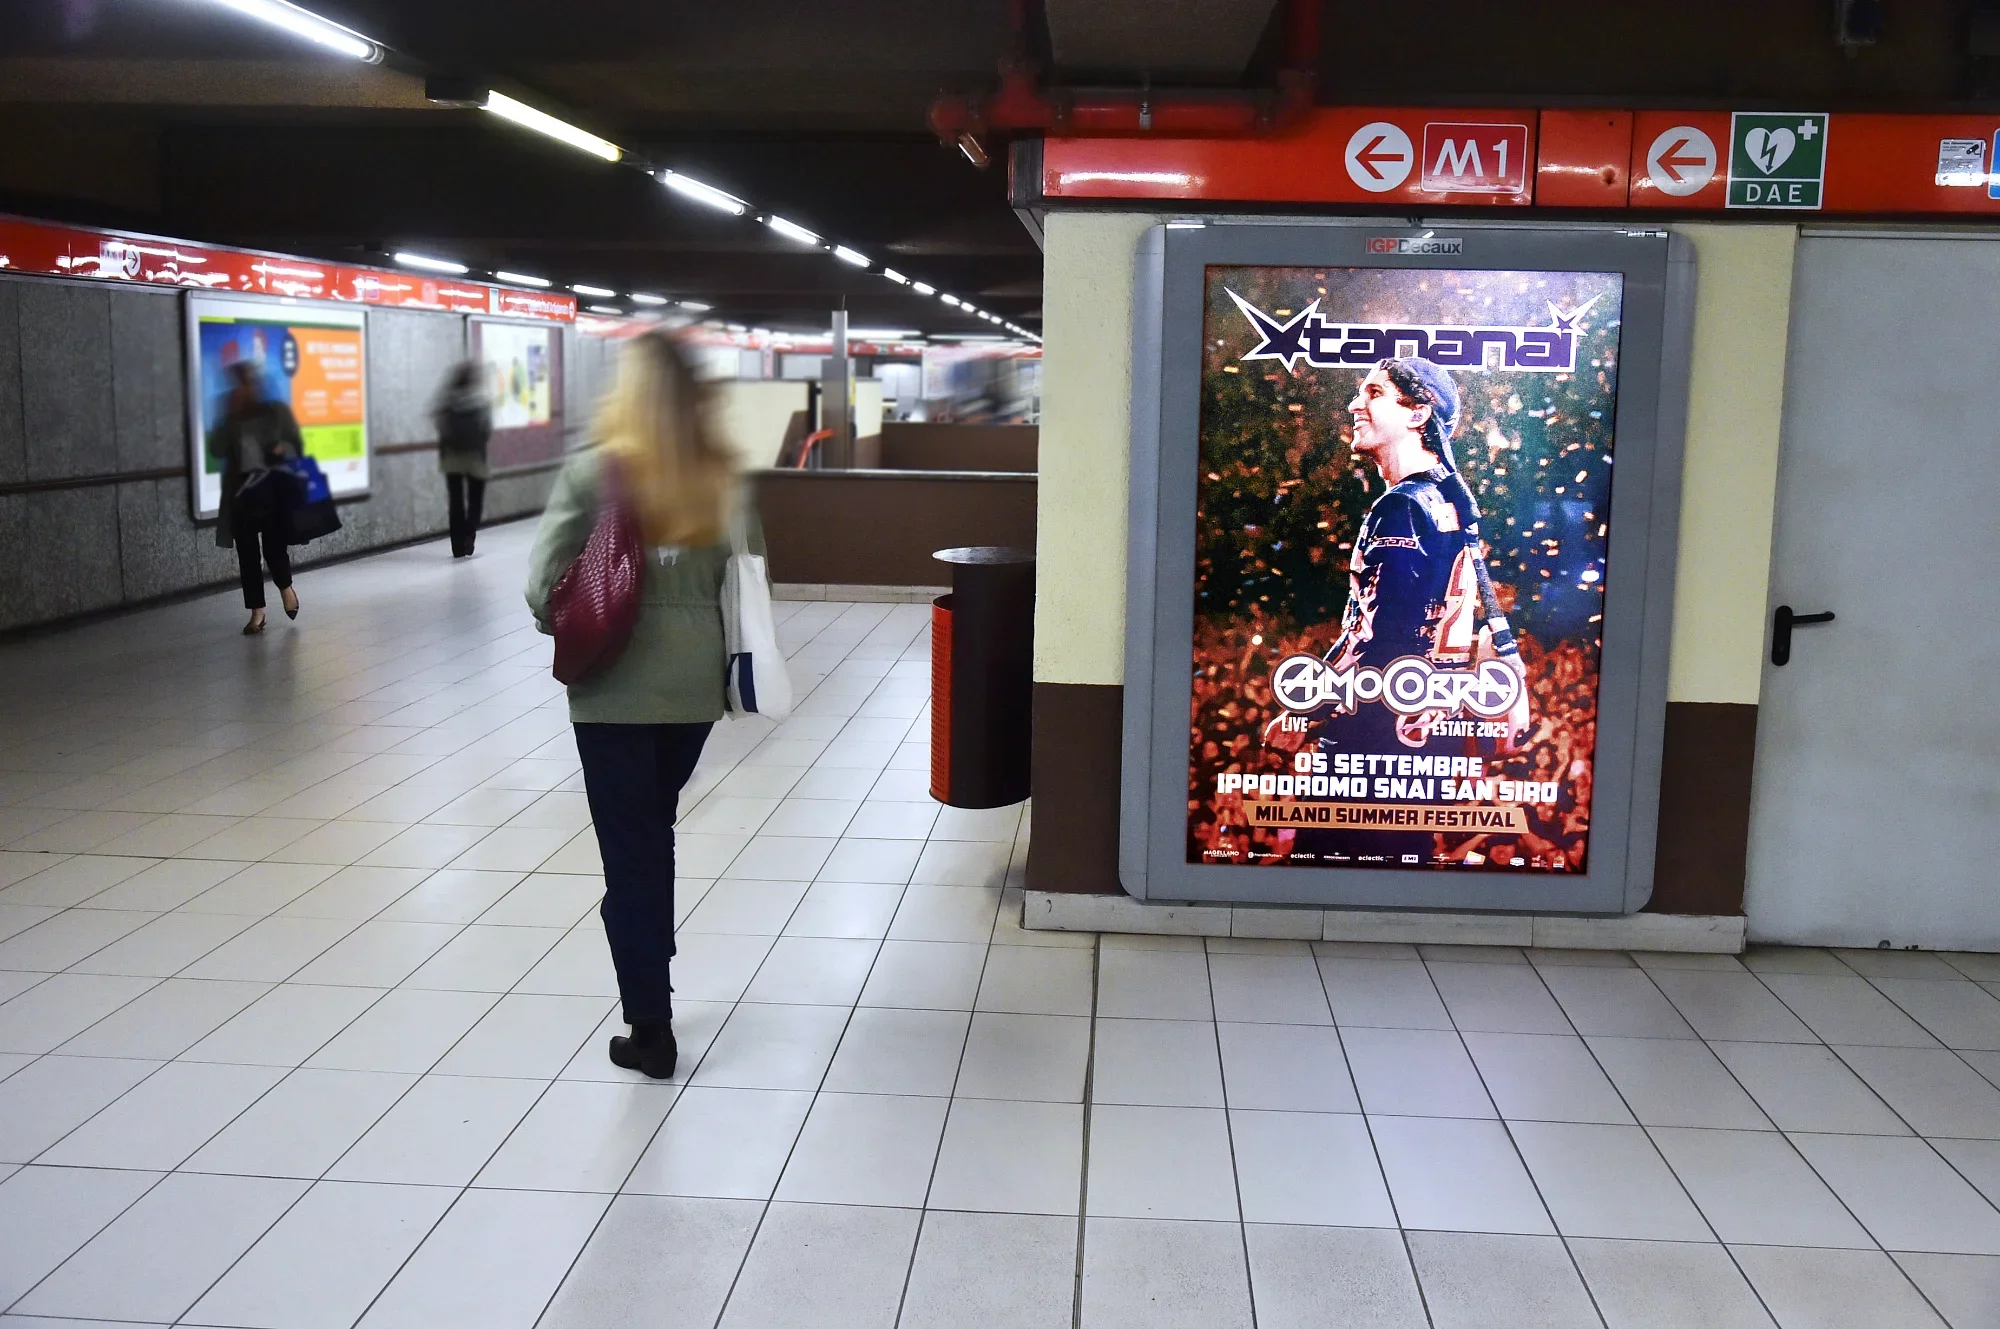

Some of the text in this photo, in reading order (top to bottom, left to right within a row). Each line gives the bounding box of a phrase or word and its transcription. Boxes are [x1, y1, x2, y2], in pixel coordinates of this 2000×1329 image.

[1432, 138, 1508, 178] M1
[1746, 183, 1803, 203] DAE
[1366, 237, 1461, 254] IGPDecaux
[1302, 311, 1578, 371] tananai
[1281, 716, 1309, 733] LIVE
[1432, 720, 1509, 738] ESTATE 2025
[1294, 752, 1483, 777] 05 SETTEMBRE
[1217, 773, 1559, 803] IPPODROMO SNAI SAN SIRO
[1255, 805, 1516, 828] MILANO SUMMER FESTIVAL
